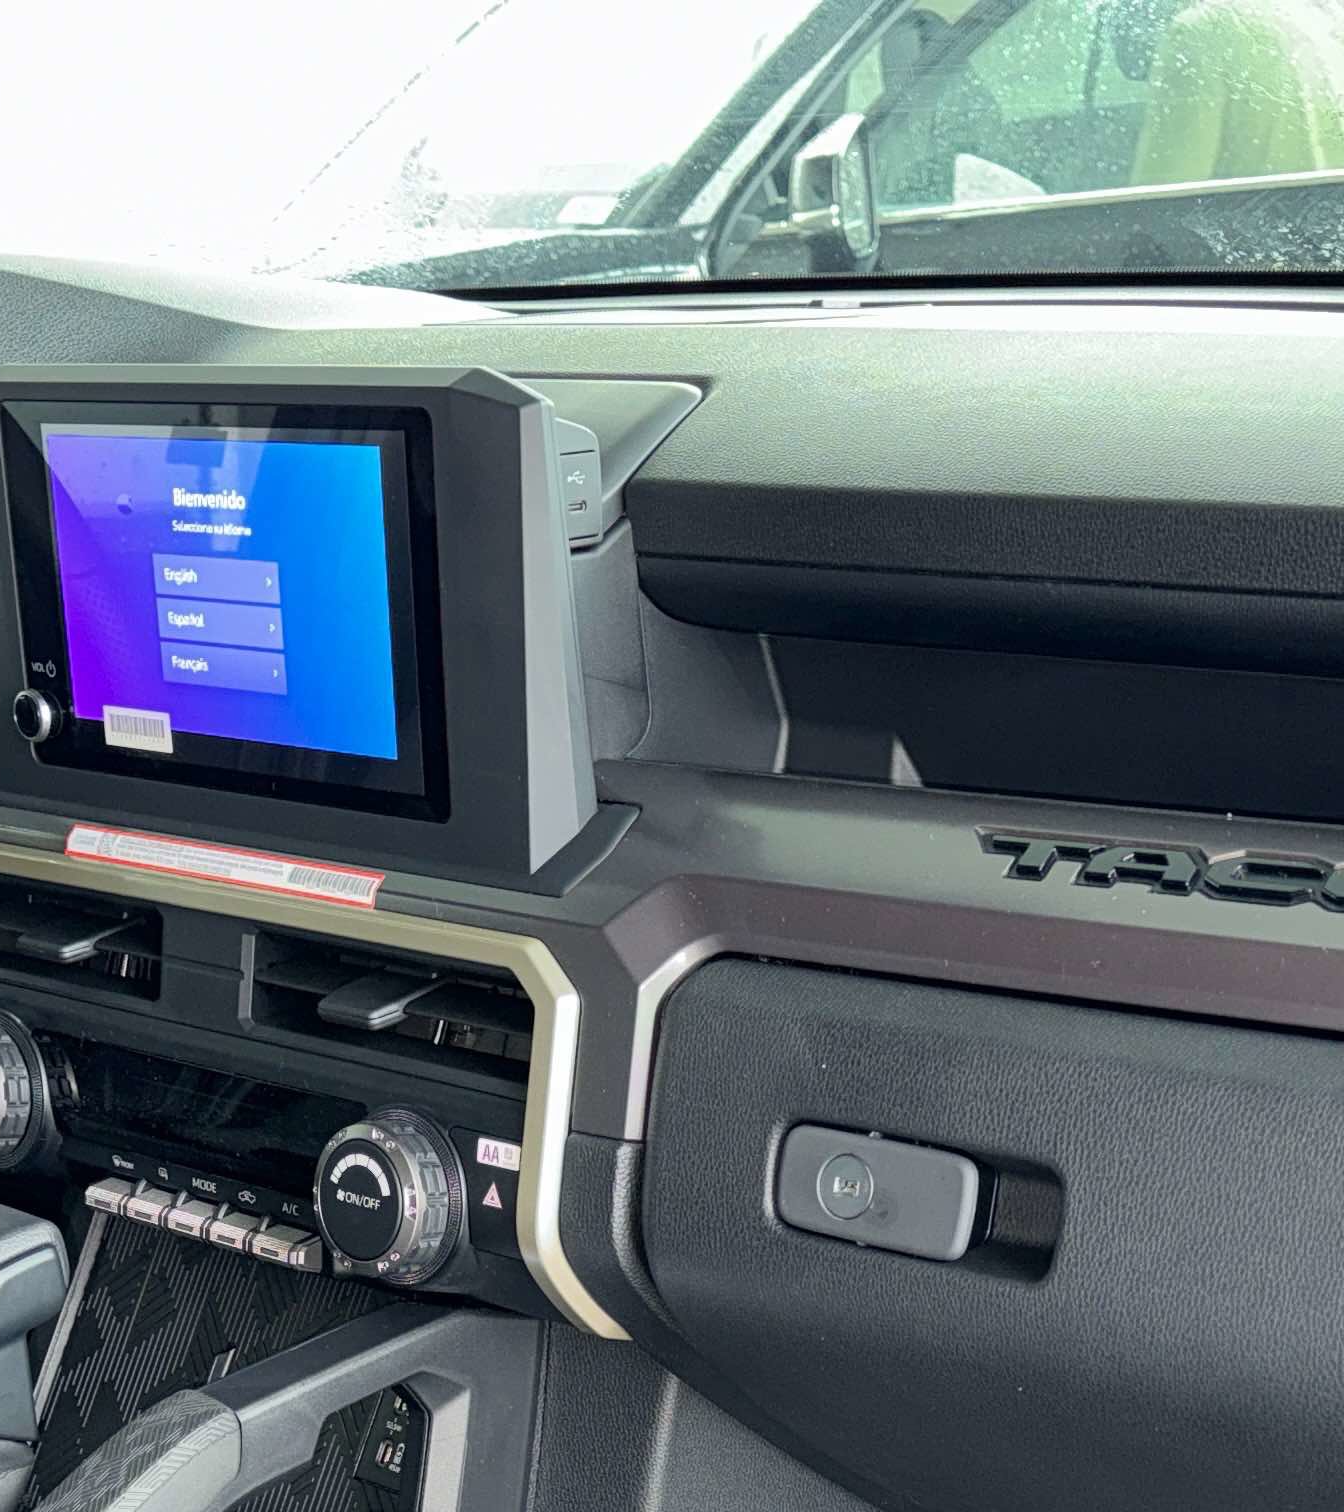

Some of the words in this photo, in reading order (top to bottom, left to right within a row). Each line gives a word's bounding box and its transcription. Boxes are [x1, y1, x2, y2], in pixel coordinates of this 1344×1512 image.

[172, 487, 246, 510] Bienvenido
[163, 567, 198, 585] English
[167, 611, 205, 628] Español
[171, 655, 208, 672] Français
[482, 1143, 500, 1164] AA
[192, 1177, 217, 1194] MODE
[282, 1202, 300, 1216] A/C
[345, 1191, 381, 1210] ON/OFF
